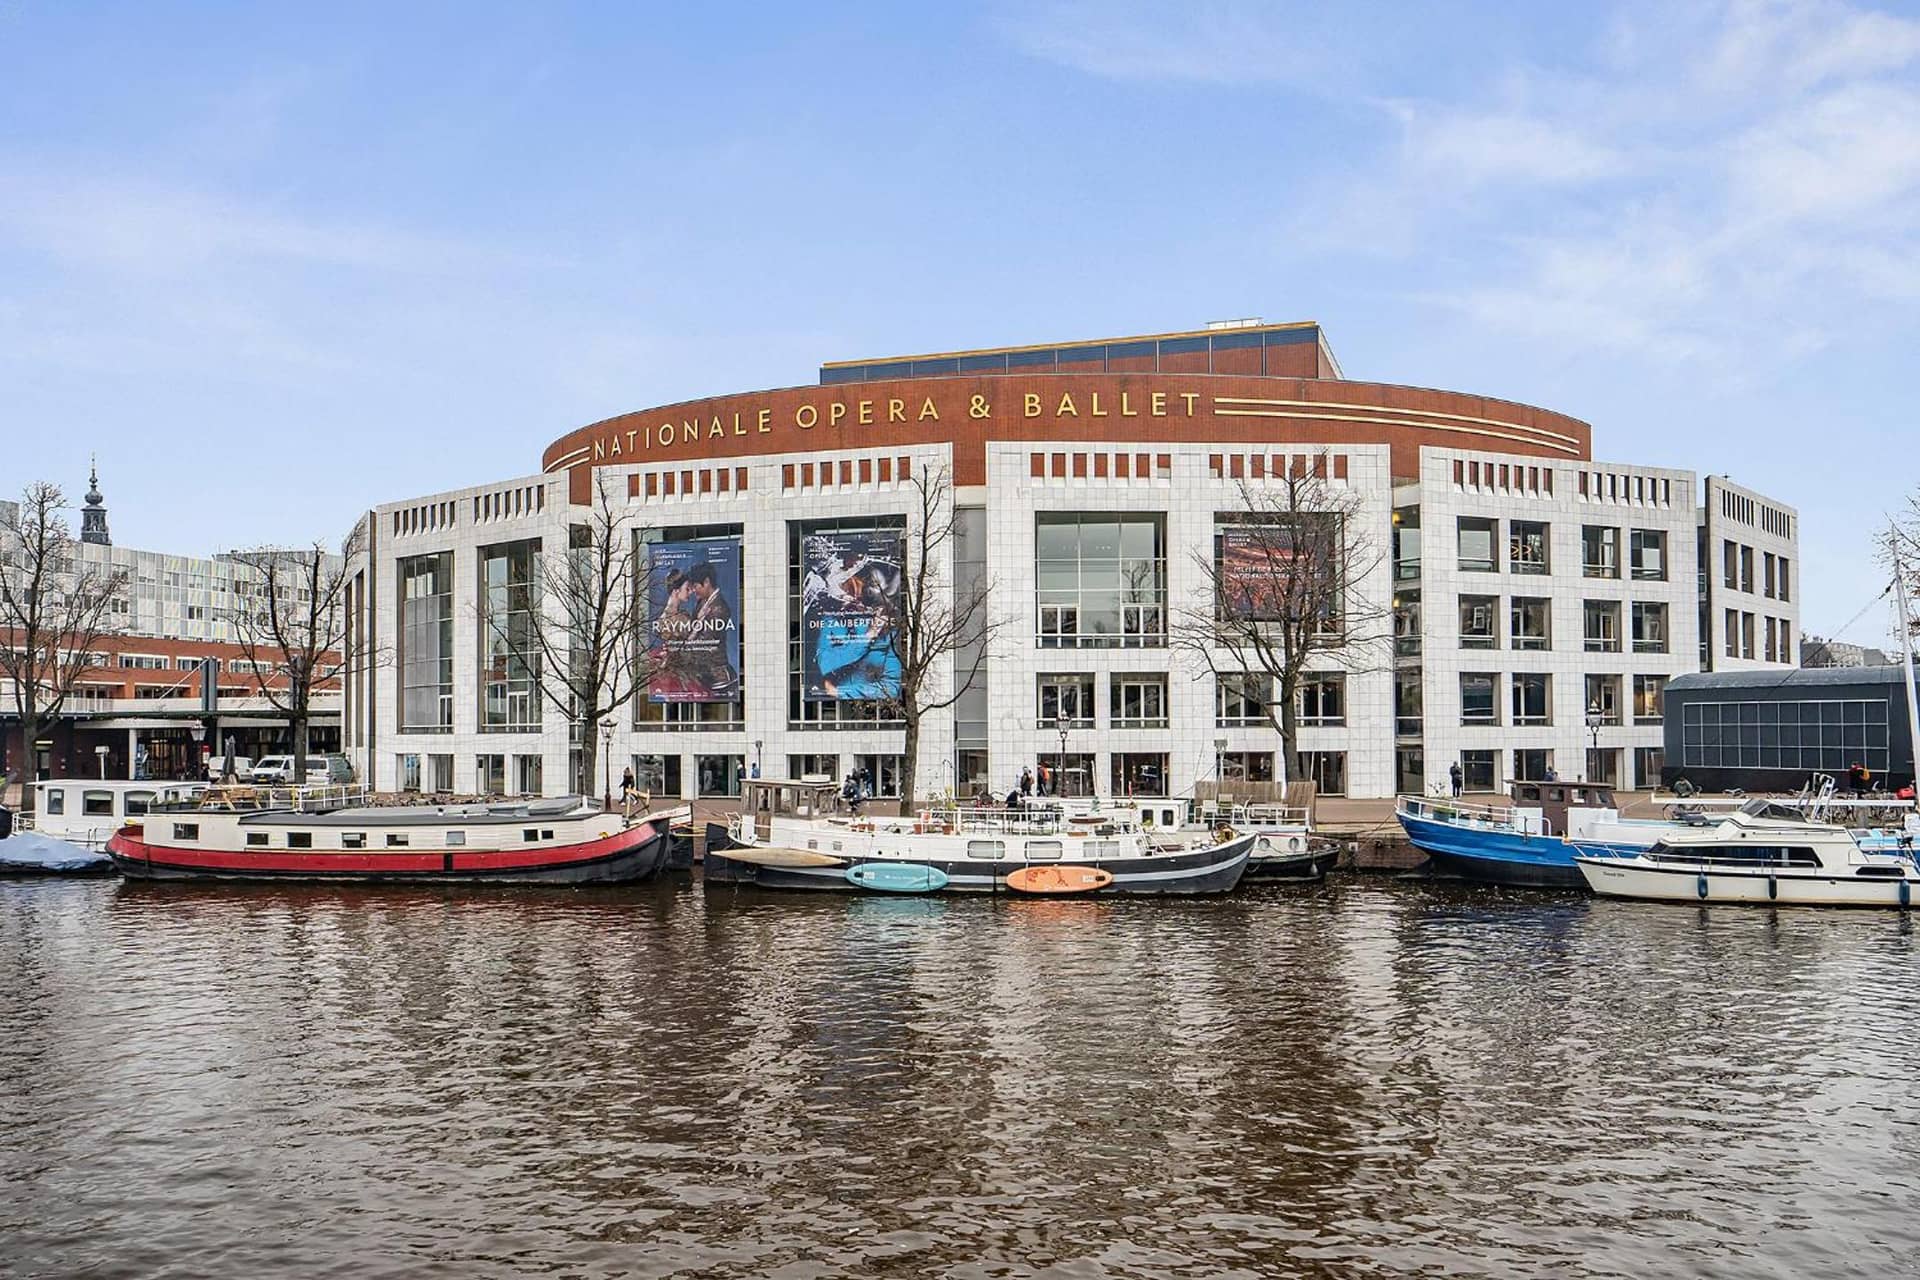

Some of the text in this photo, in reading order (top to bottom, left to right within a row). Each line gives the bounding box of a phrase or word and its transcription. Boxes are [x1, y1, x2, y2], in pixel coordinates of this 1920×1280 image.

[593, 392, 1200, 461] NATIONALE OPERA & BALLET
[651, 618, 736, 633] RAYMONDA
[809, 617, 897, 629] DIE ZAUBERFLE
